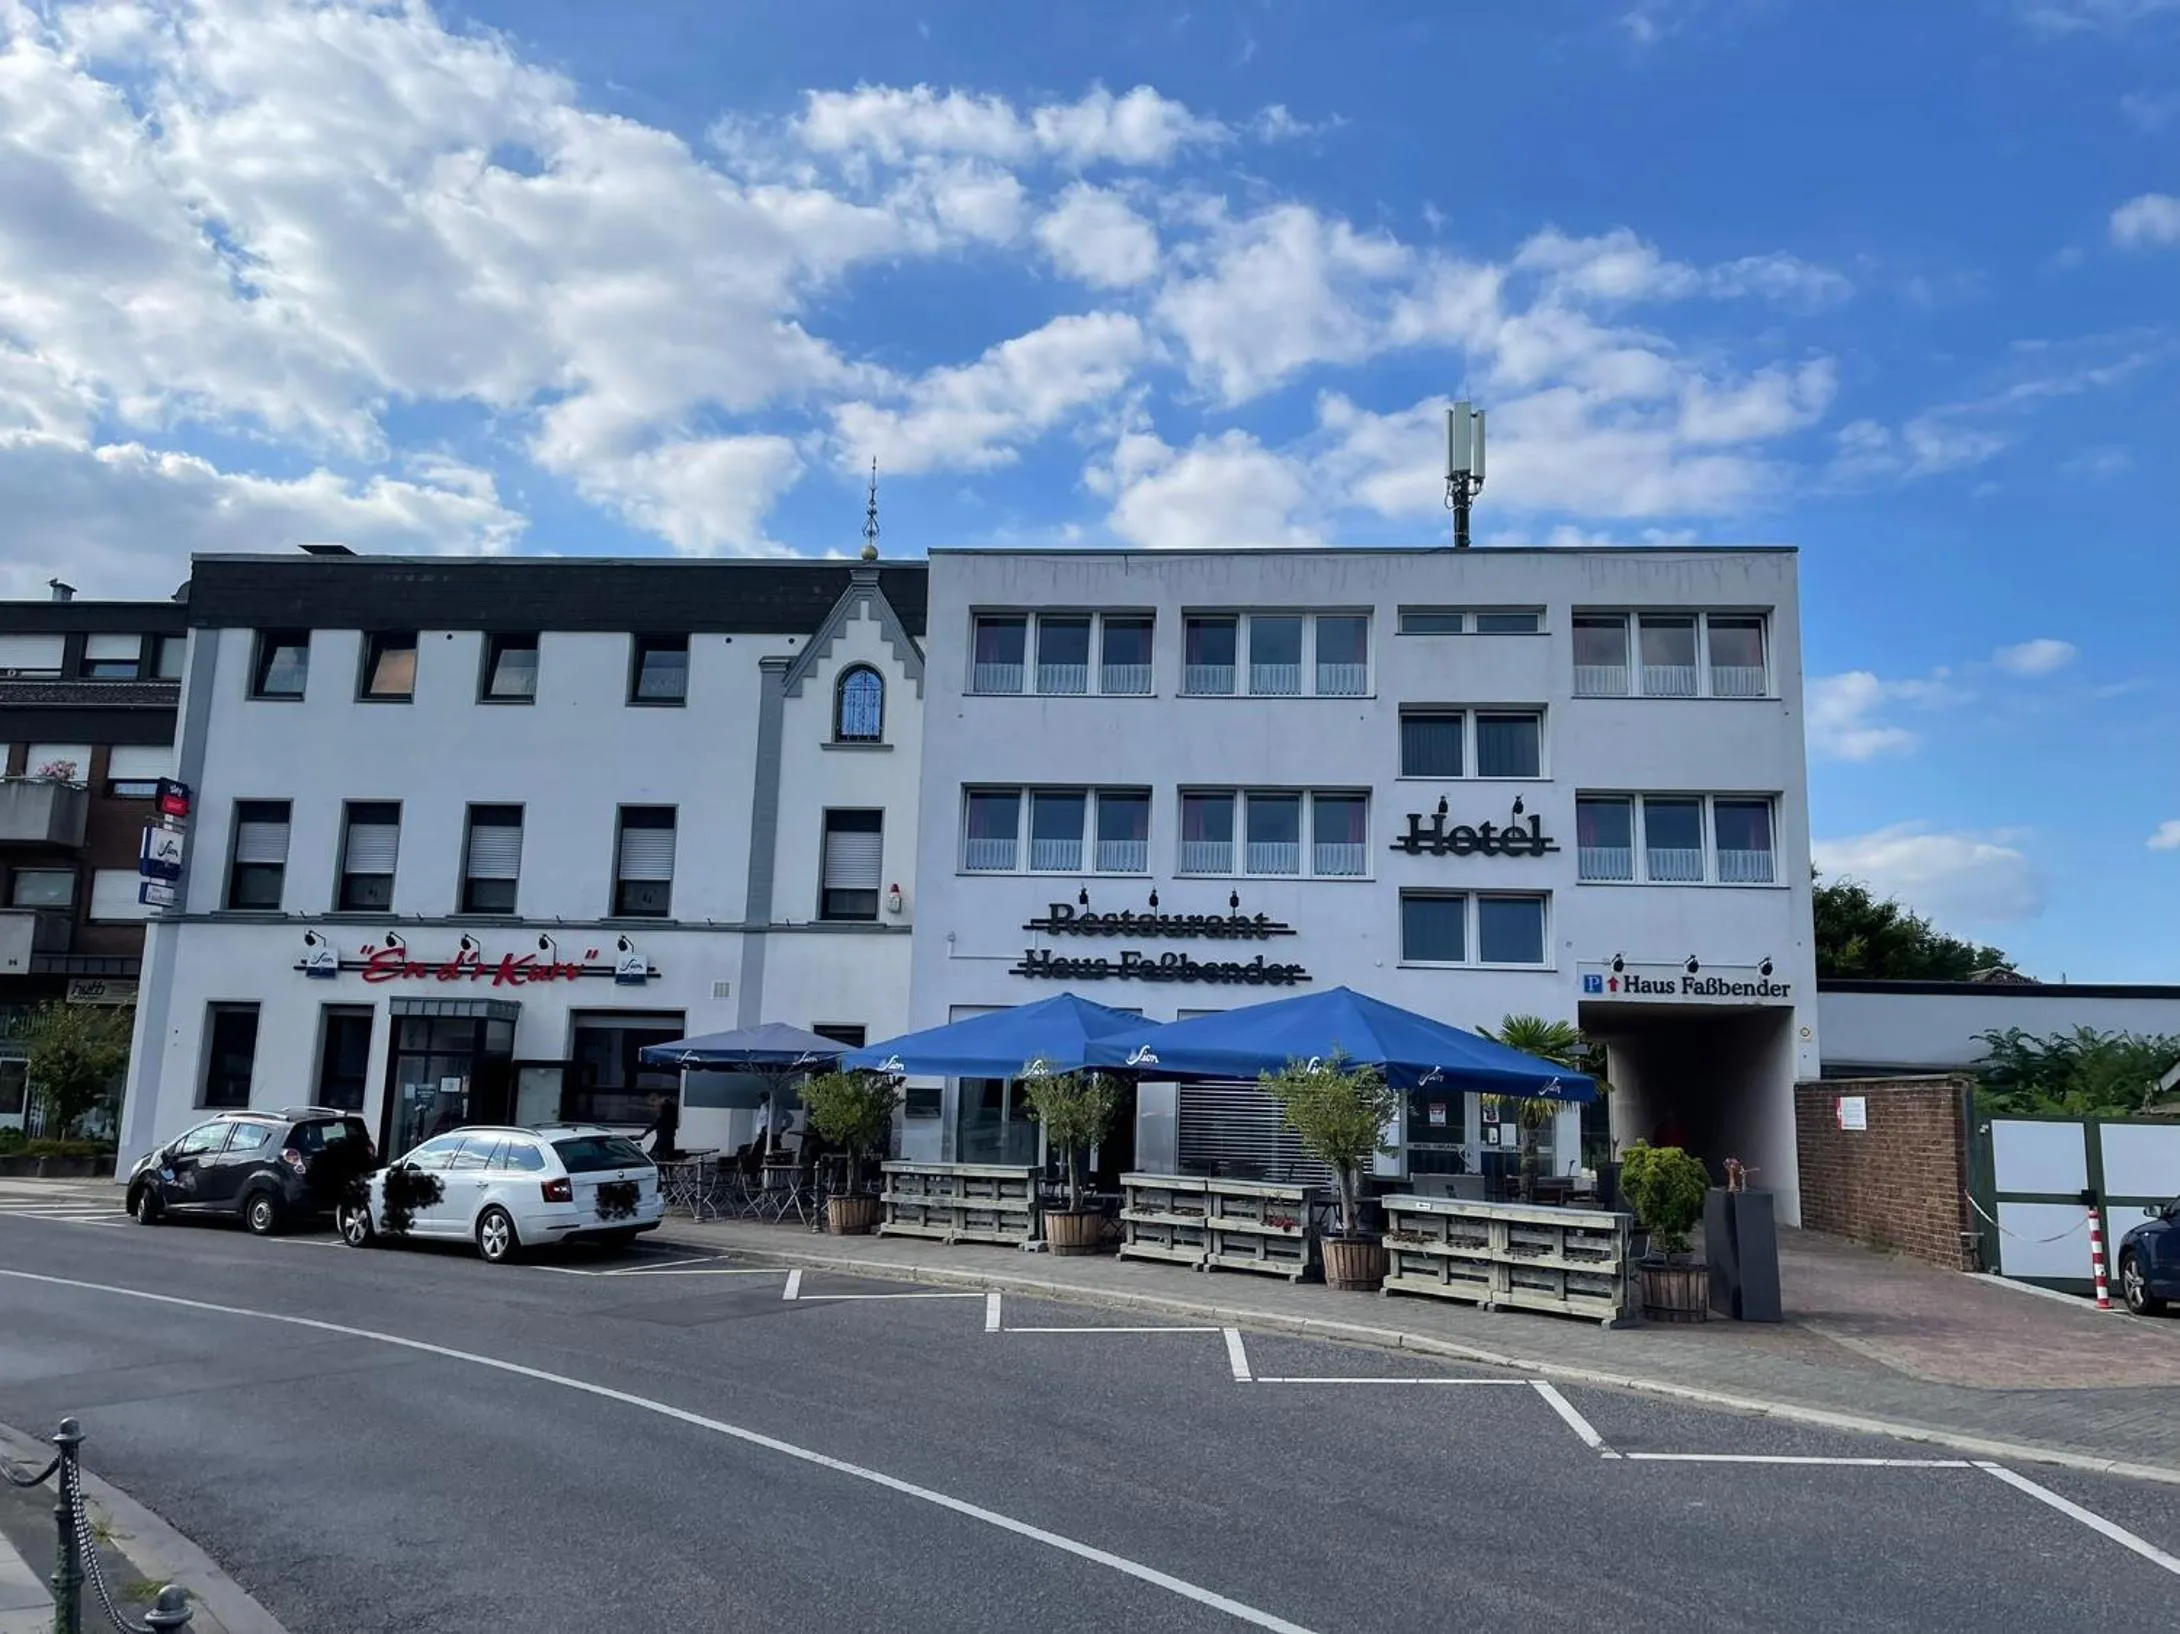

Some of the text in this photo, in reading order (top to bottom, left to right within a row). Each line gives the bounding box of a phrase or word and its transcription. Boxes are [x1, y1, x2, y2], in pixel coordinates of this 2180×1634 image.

[1405, 813, 1546, 857] Hotel
[1048, 903, 1271, 940] Restaurant
[1024, 949, 1304, 985] Haus Faßbender
[1623, 975, 1676, 993] Haus
[1682, 976, 1791, 998] Faßbender
[1126, 1044, 1159, 1065] Sion
